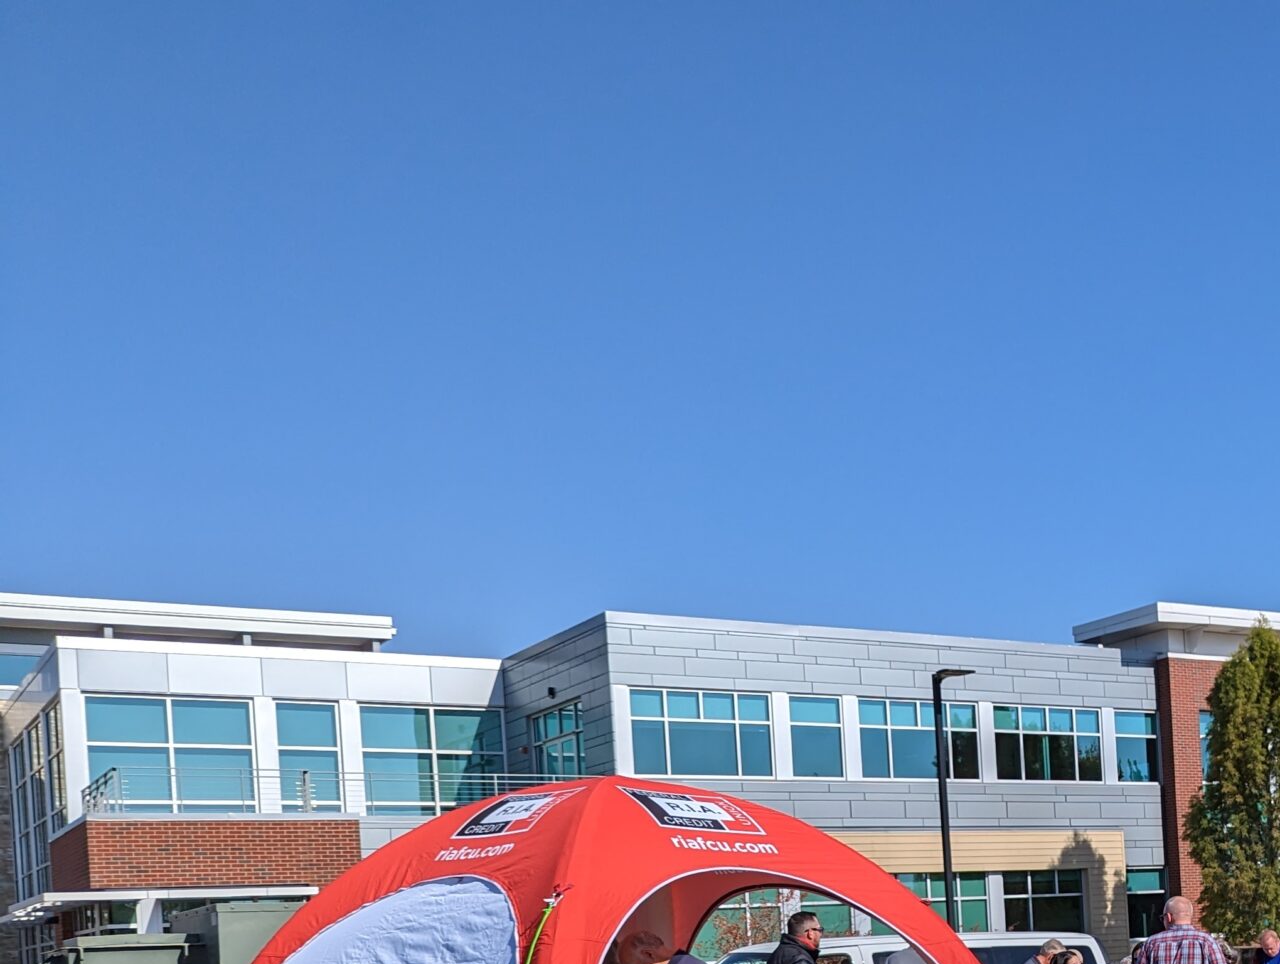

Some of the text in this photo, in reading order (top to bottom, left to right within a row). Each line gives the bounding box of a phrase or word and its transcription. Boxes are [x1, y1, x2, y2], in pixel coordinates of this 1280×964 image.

[495, 803, 534, 816] R.I.A.
[665, 801, 722, 815] R.I.A.
[717, 800, 752, 826] UNION
[464, 822, 506, 835] CREDIT
[664, 816, 715, 828] CREDIT
[434, 842, 515, 861] riafcu.com
[670, 834, 779, 855] riafcu.com
